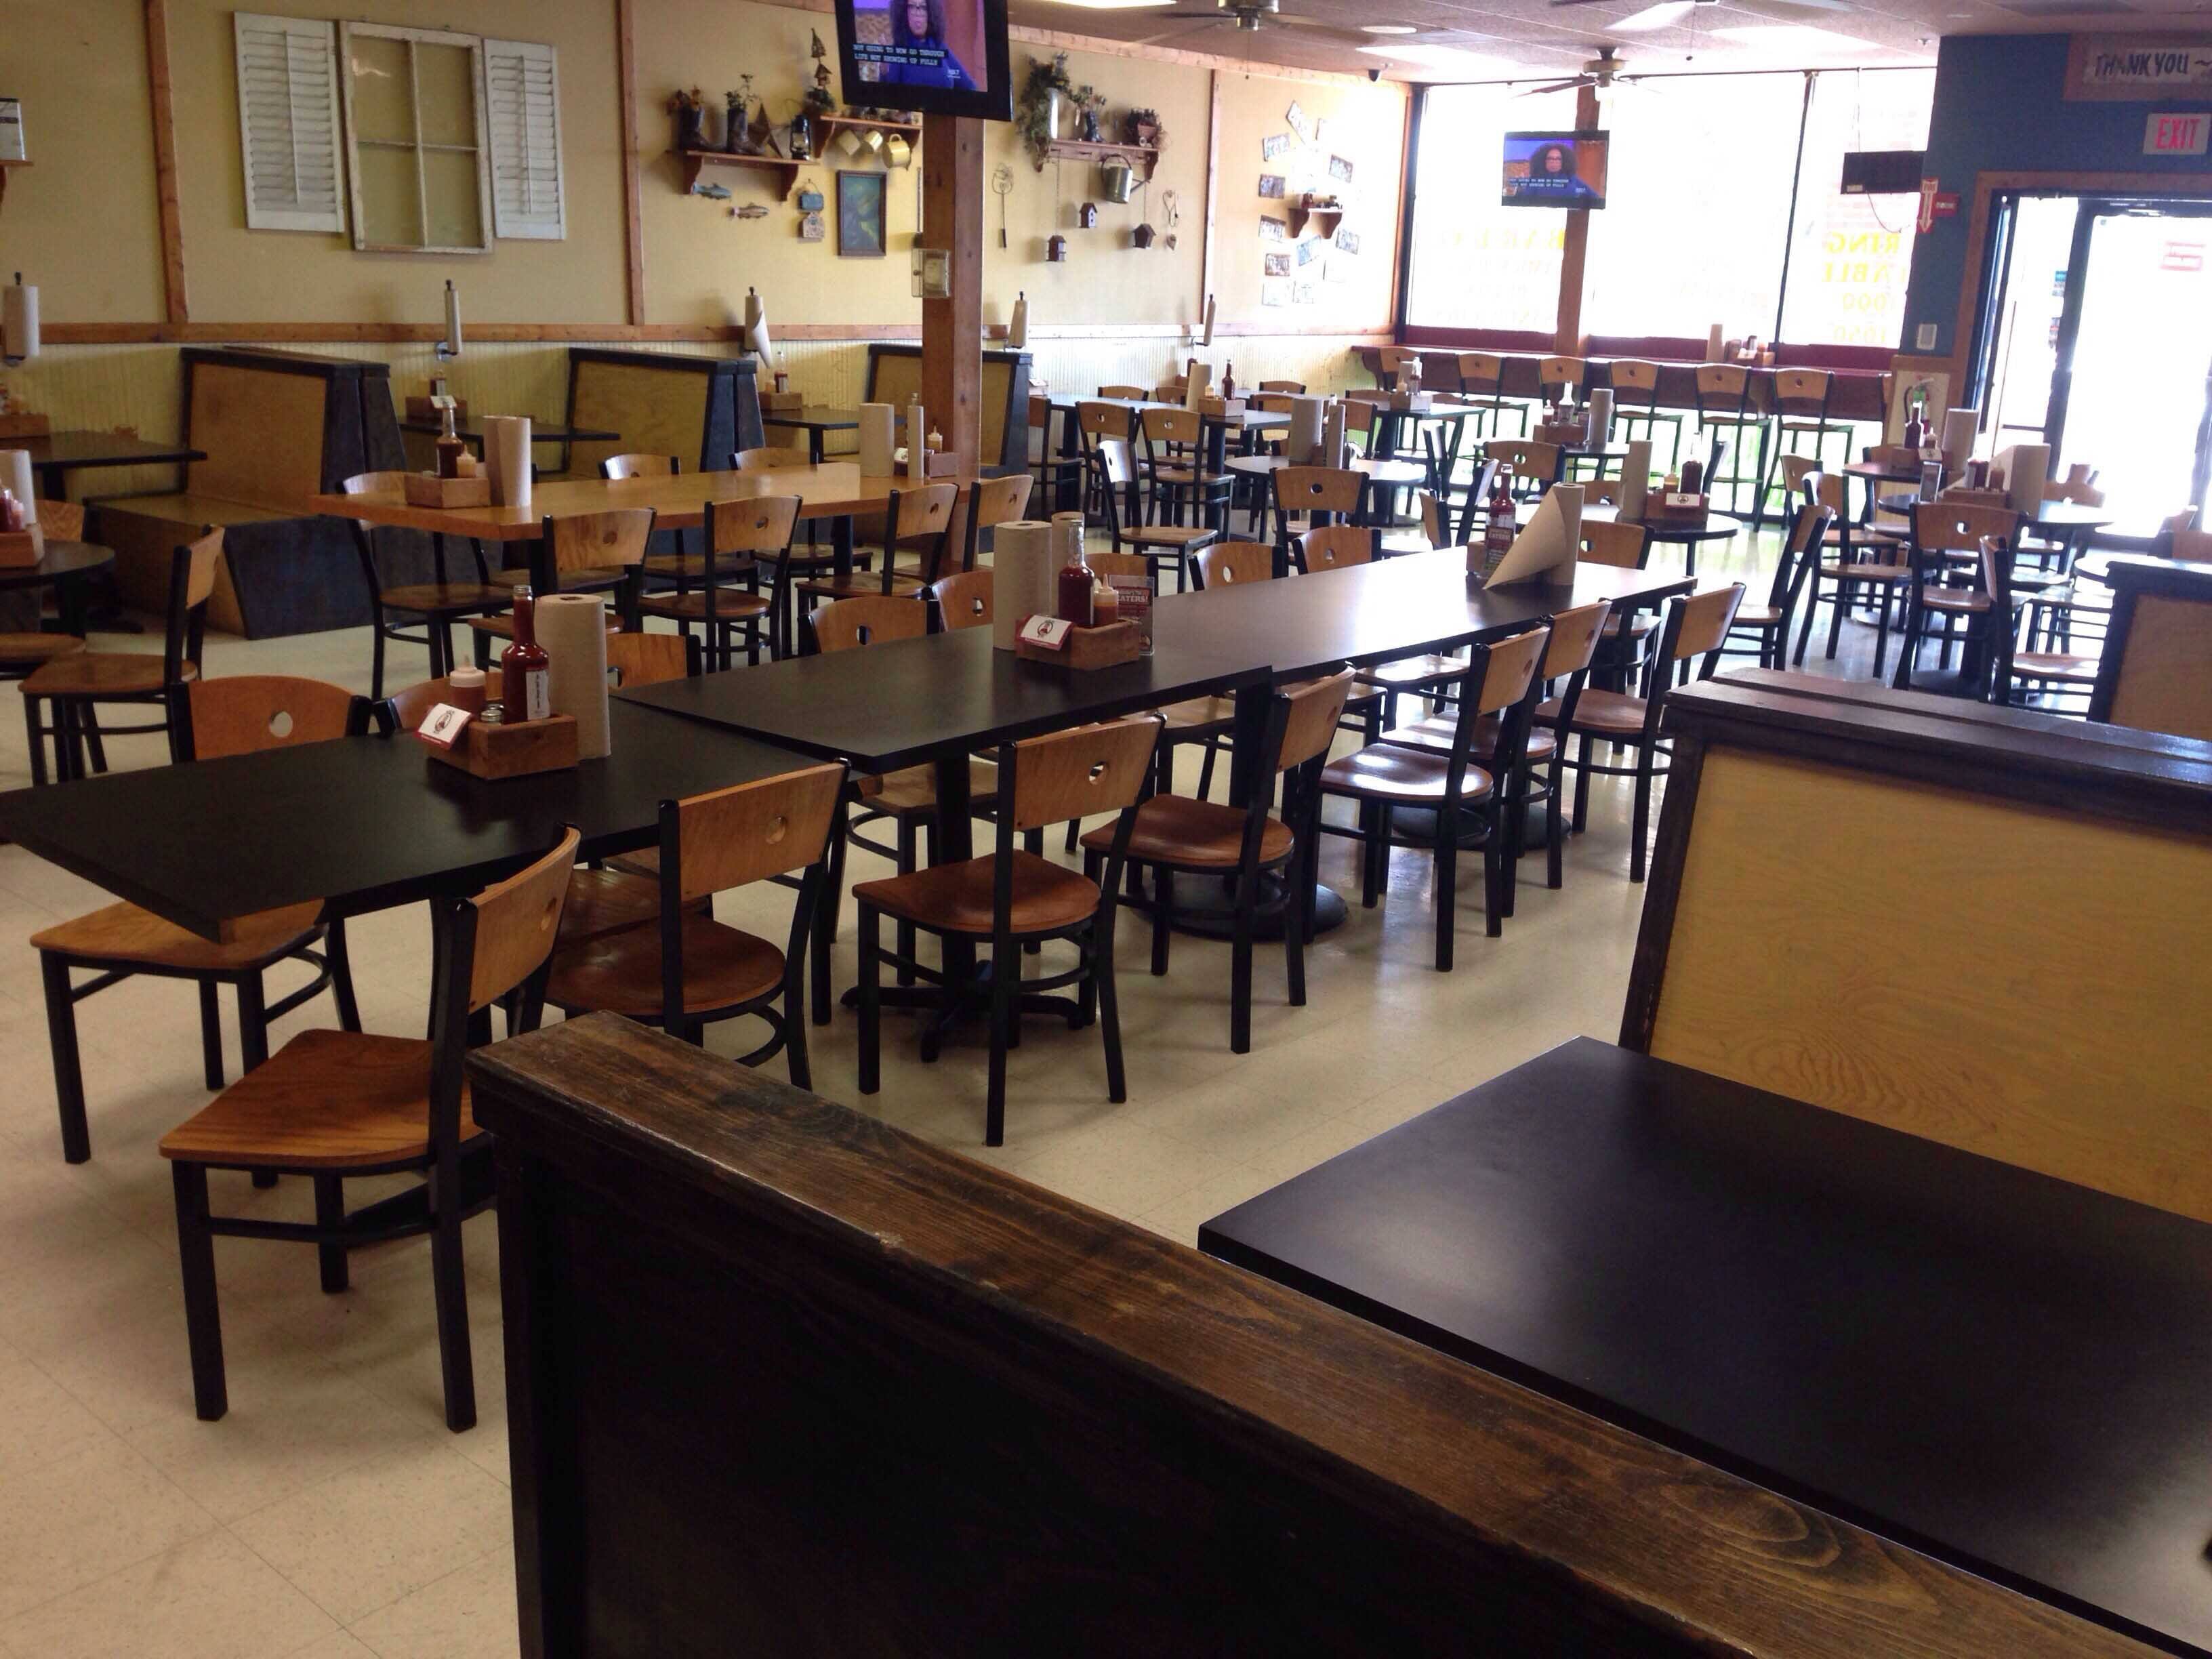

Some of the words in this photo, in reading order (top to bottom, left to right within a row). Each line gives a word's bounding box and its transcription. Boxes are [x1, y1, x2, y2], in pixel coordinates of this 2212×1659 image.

[2095, 53, 2152, 77] THANK
[2154, 53, 2190, 77] YOU
[2155, 116, 2201, 150] EXIT
